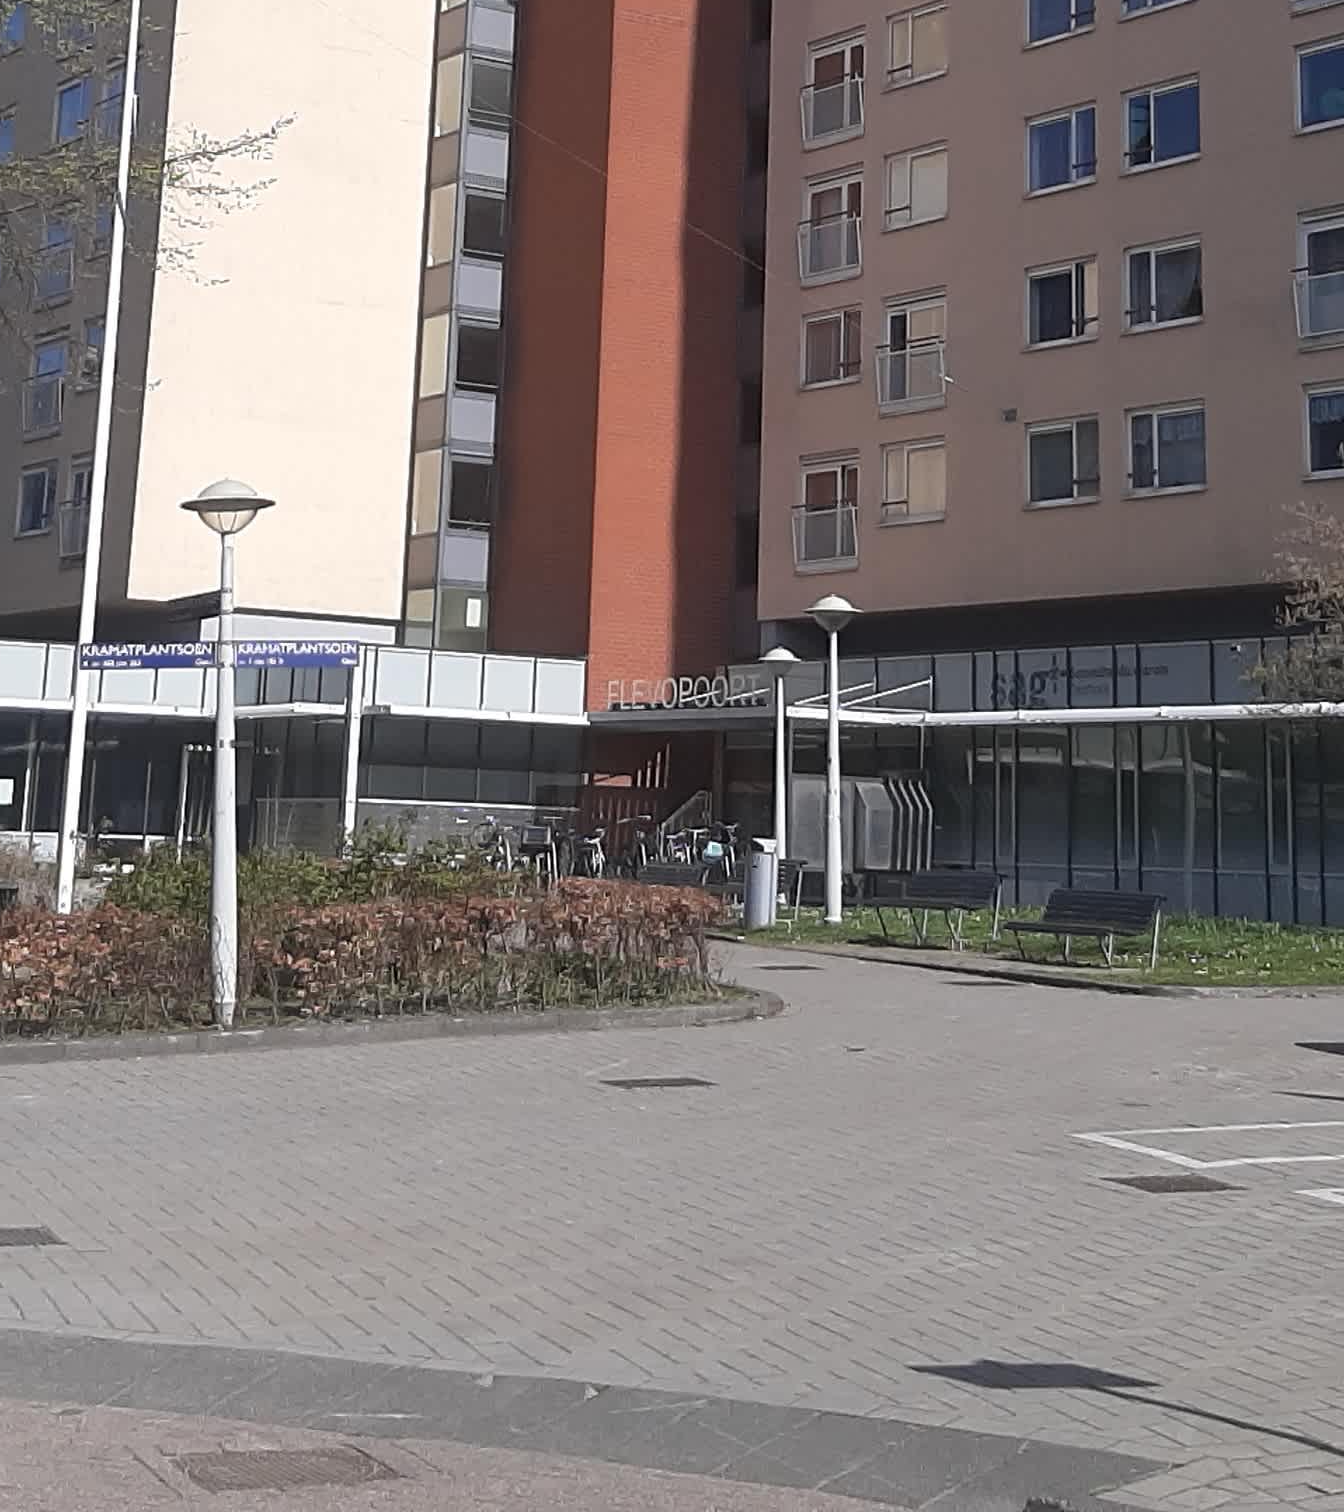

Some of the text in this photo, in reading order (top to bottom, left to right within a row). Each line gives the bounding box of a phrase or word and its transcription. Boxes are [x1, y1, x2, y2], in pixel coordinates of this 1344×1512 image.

[82, 643, 213, 656] KRAMATPLANTSOEN
[238, 642, 357, 655] KRAMATPLANTSOEN
[607, 675, 760, 710] FLEVOPOORT
